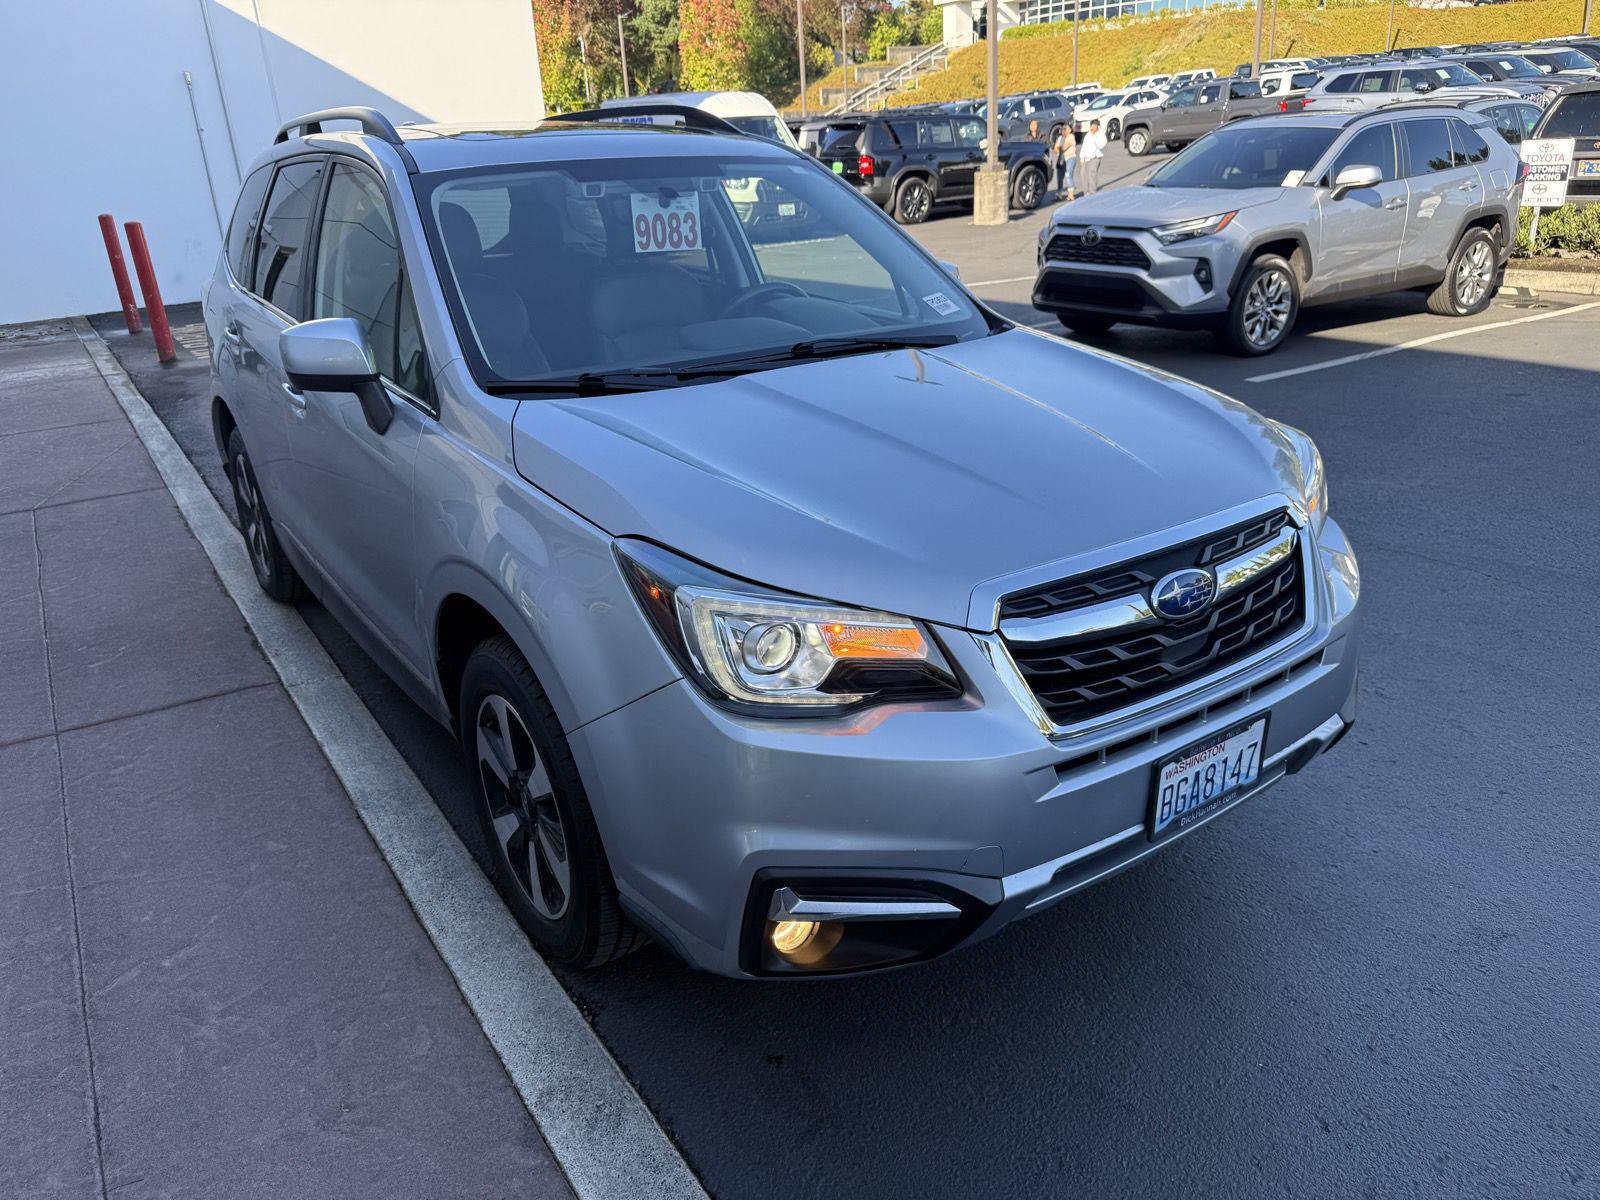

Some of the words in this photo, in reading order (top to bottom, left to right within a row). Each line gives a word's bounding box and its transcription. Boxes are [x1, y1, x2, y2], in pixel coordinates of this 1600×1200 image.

[1525, 153, 1565, 163] TOYOTA
[1526, 173, 1561, 181] ARKING
[635, 211, 698, 250] 9083
[1165, 742, 1226, 780] WASHINGTON
[1159, 740, 1259, 825] BGA8147
